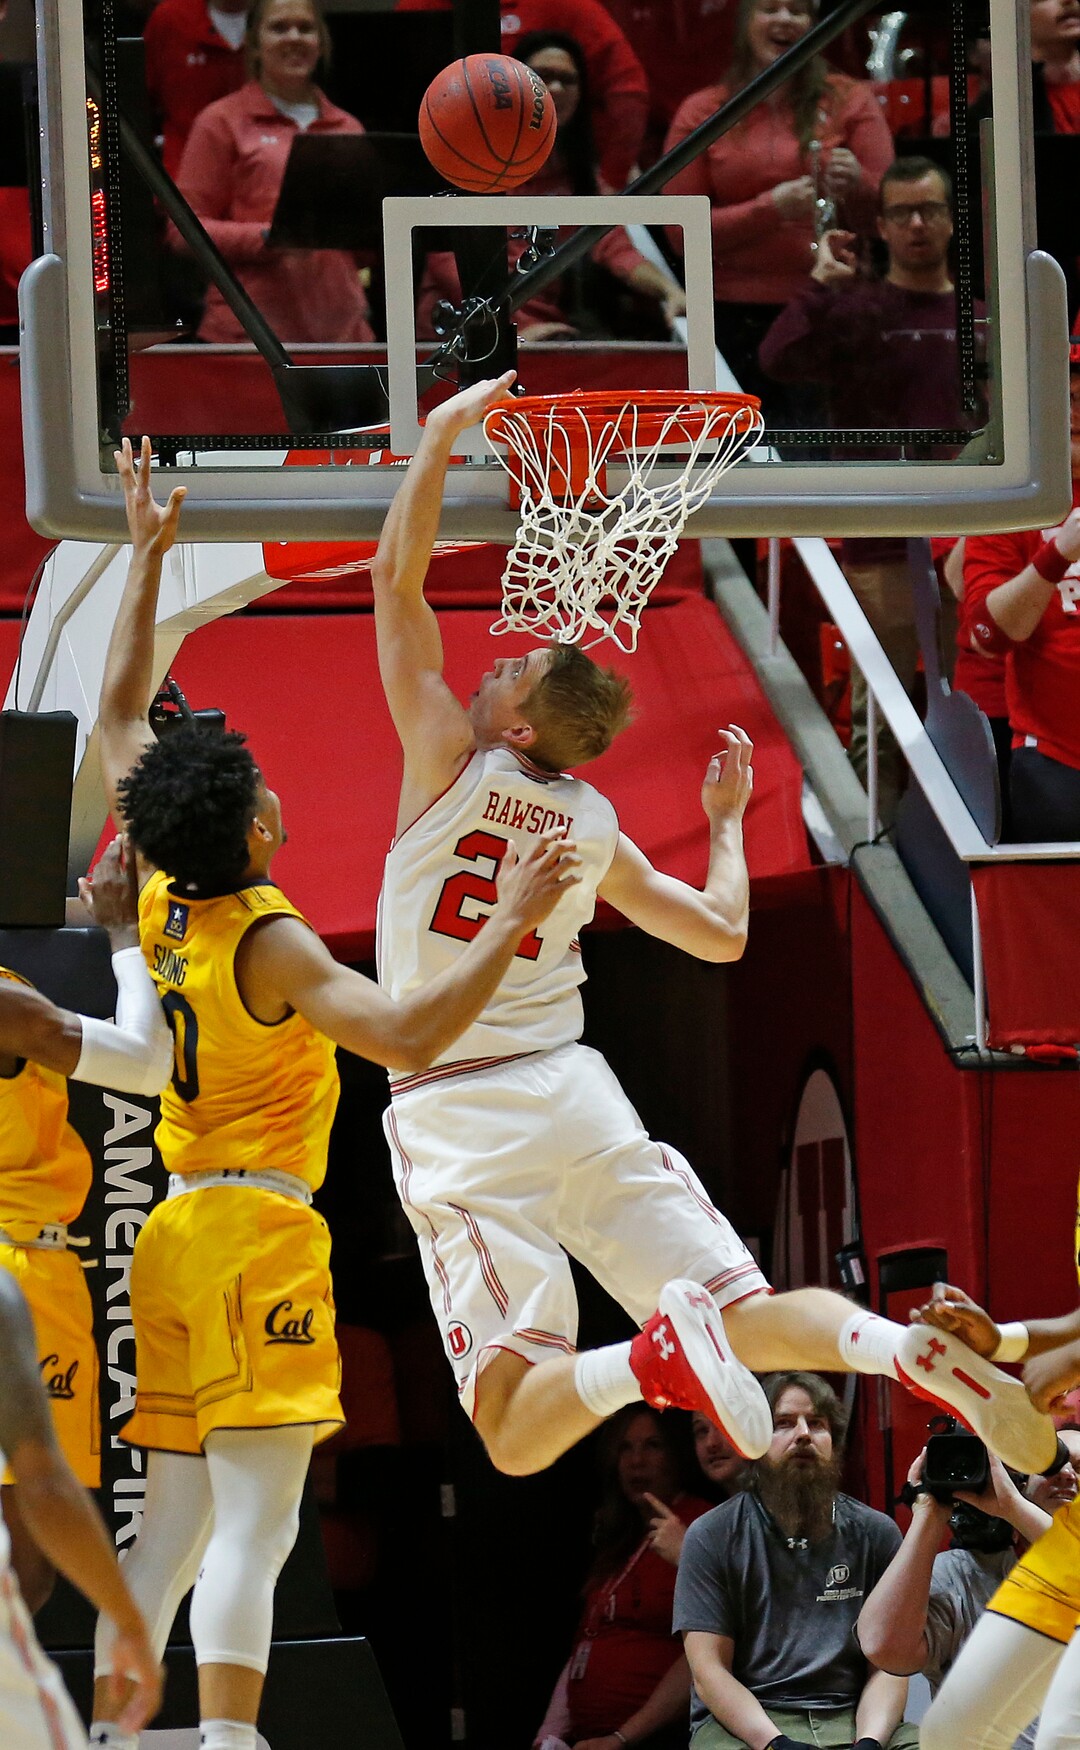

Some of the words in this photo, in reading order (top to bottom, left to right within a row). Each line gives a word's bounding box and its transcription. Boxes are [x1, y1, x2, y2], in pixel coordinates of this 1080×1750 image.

[486, 60, 513, 110] NCAA
[482, 791, 573, 841] RAWSON
[264, 1300, 315, 1345] Cal
